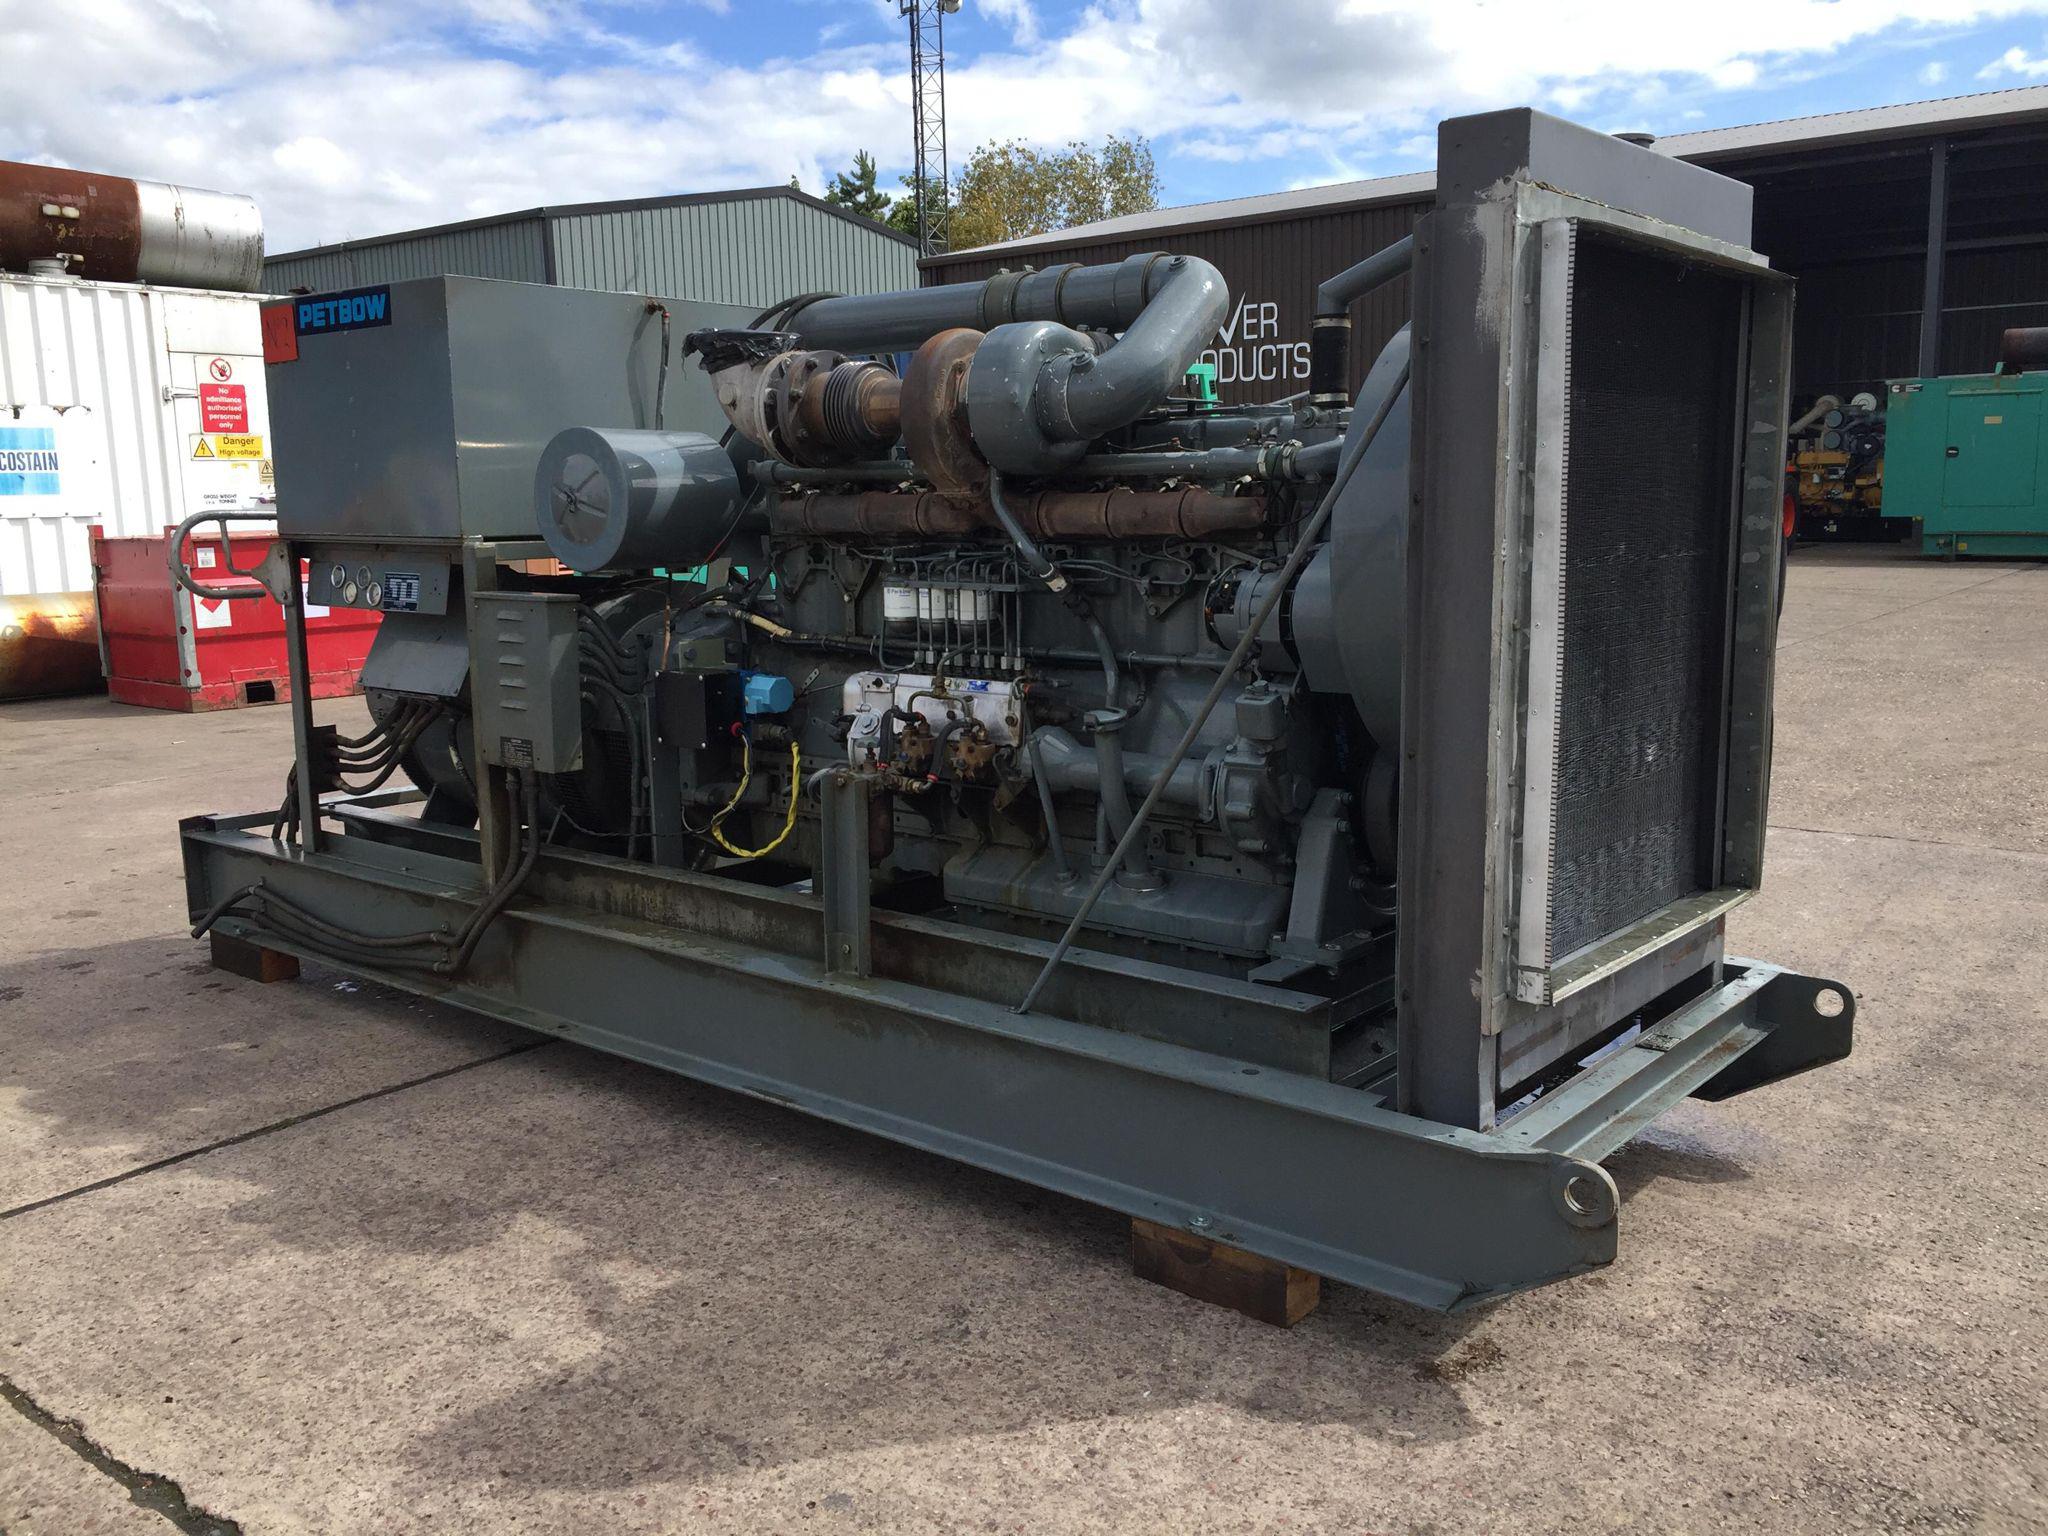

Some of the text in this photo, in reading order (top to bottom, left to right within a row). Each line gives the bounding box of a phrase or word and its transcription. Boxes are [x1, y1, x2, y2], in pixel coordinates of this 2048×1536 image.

[299, 293, 386, 329] PETBOW
[1183, 342, 1311, 386] ODUCTS
[218, 387, 229, 395] No
[207, 404, 242, 412] authorised
[208, 413, 242, 421] personnel
[219, 421, 234, 430] only
[223, 436, 255, 447] Danger
[219, 449, 261, 457] High voltage
[0, 452, 59, 471] COSTAIN
